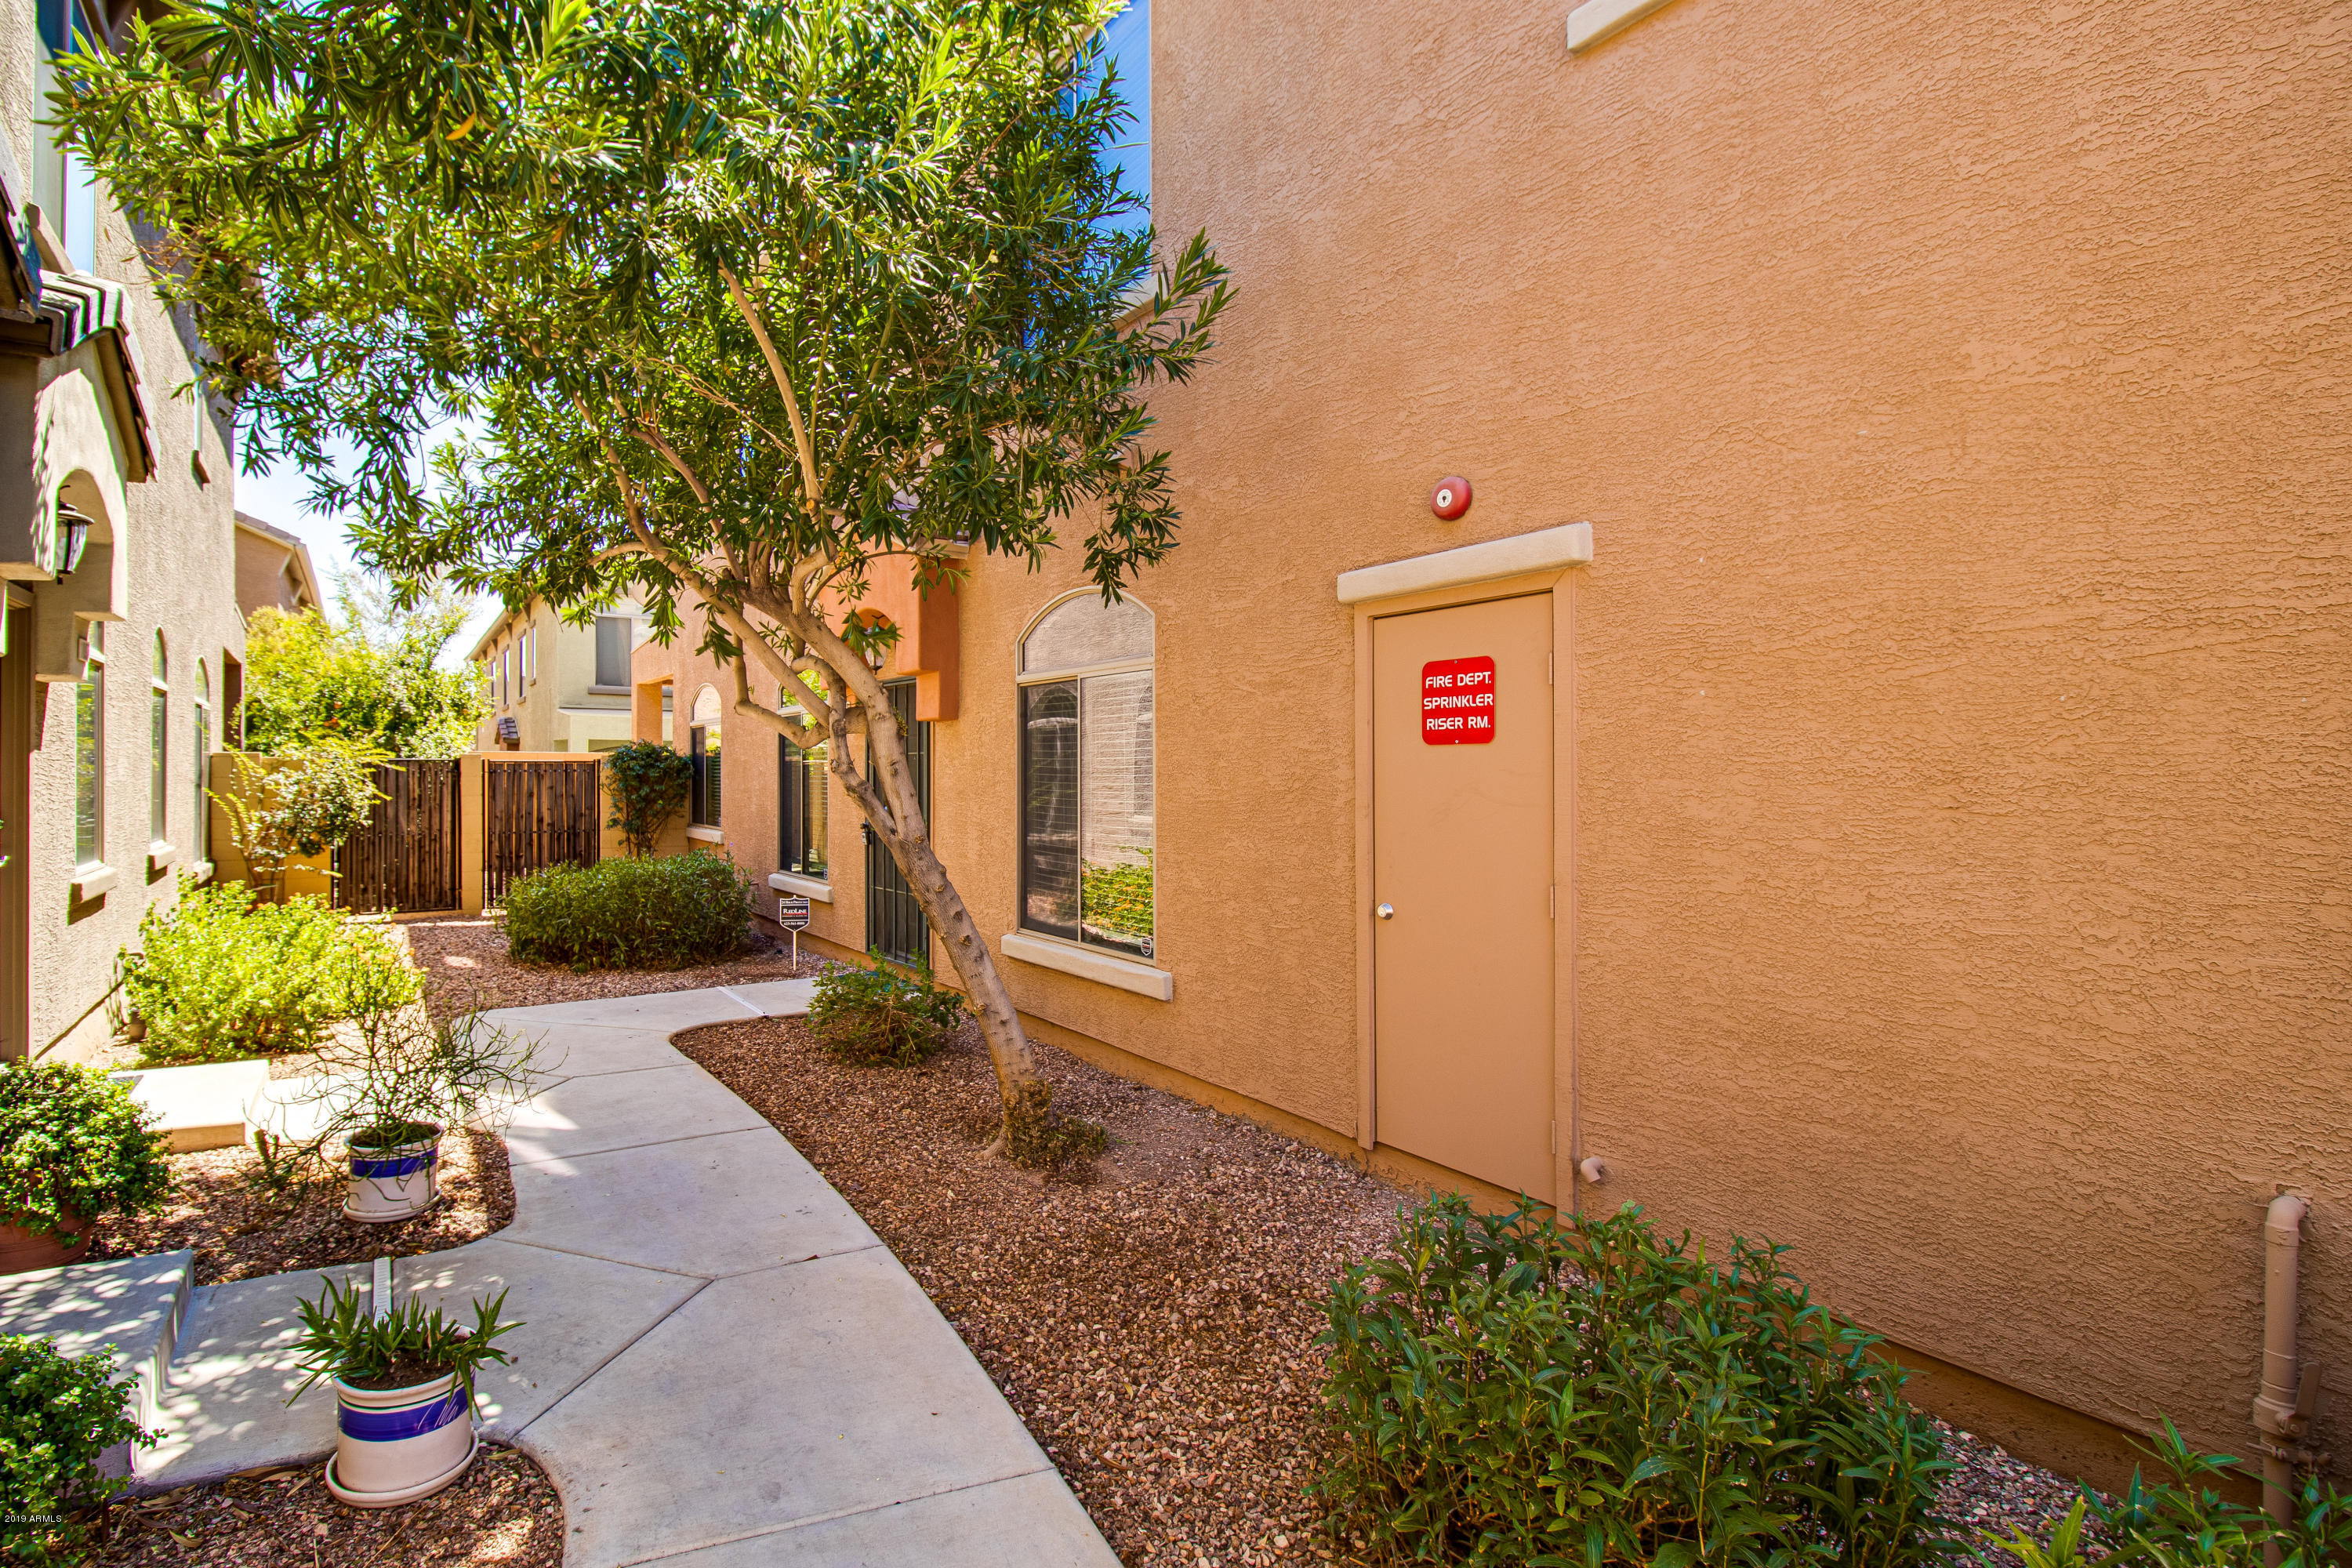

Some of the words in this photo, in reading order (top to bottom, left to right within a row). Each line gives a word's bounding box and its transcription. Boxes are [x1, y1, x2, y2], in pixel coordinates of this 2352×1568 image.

[1425, 674, 1453, 688] FIRE
[1457, 671, 1492, 686] DEPT.
[1423, 693, 1494, 710] SPRINKLER
[1426, 717, 1464, 730] RISER
[1468, 715, 1491, 728] RM.
